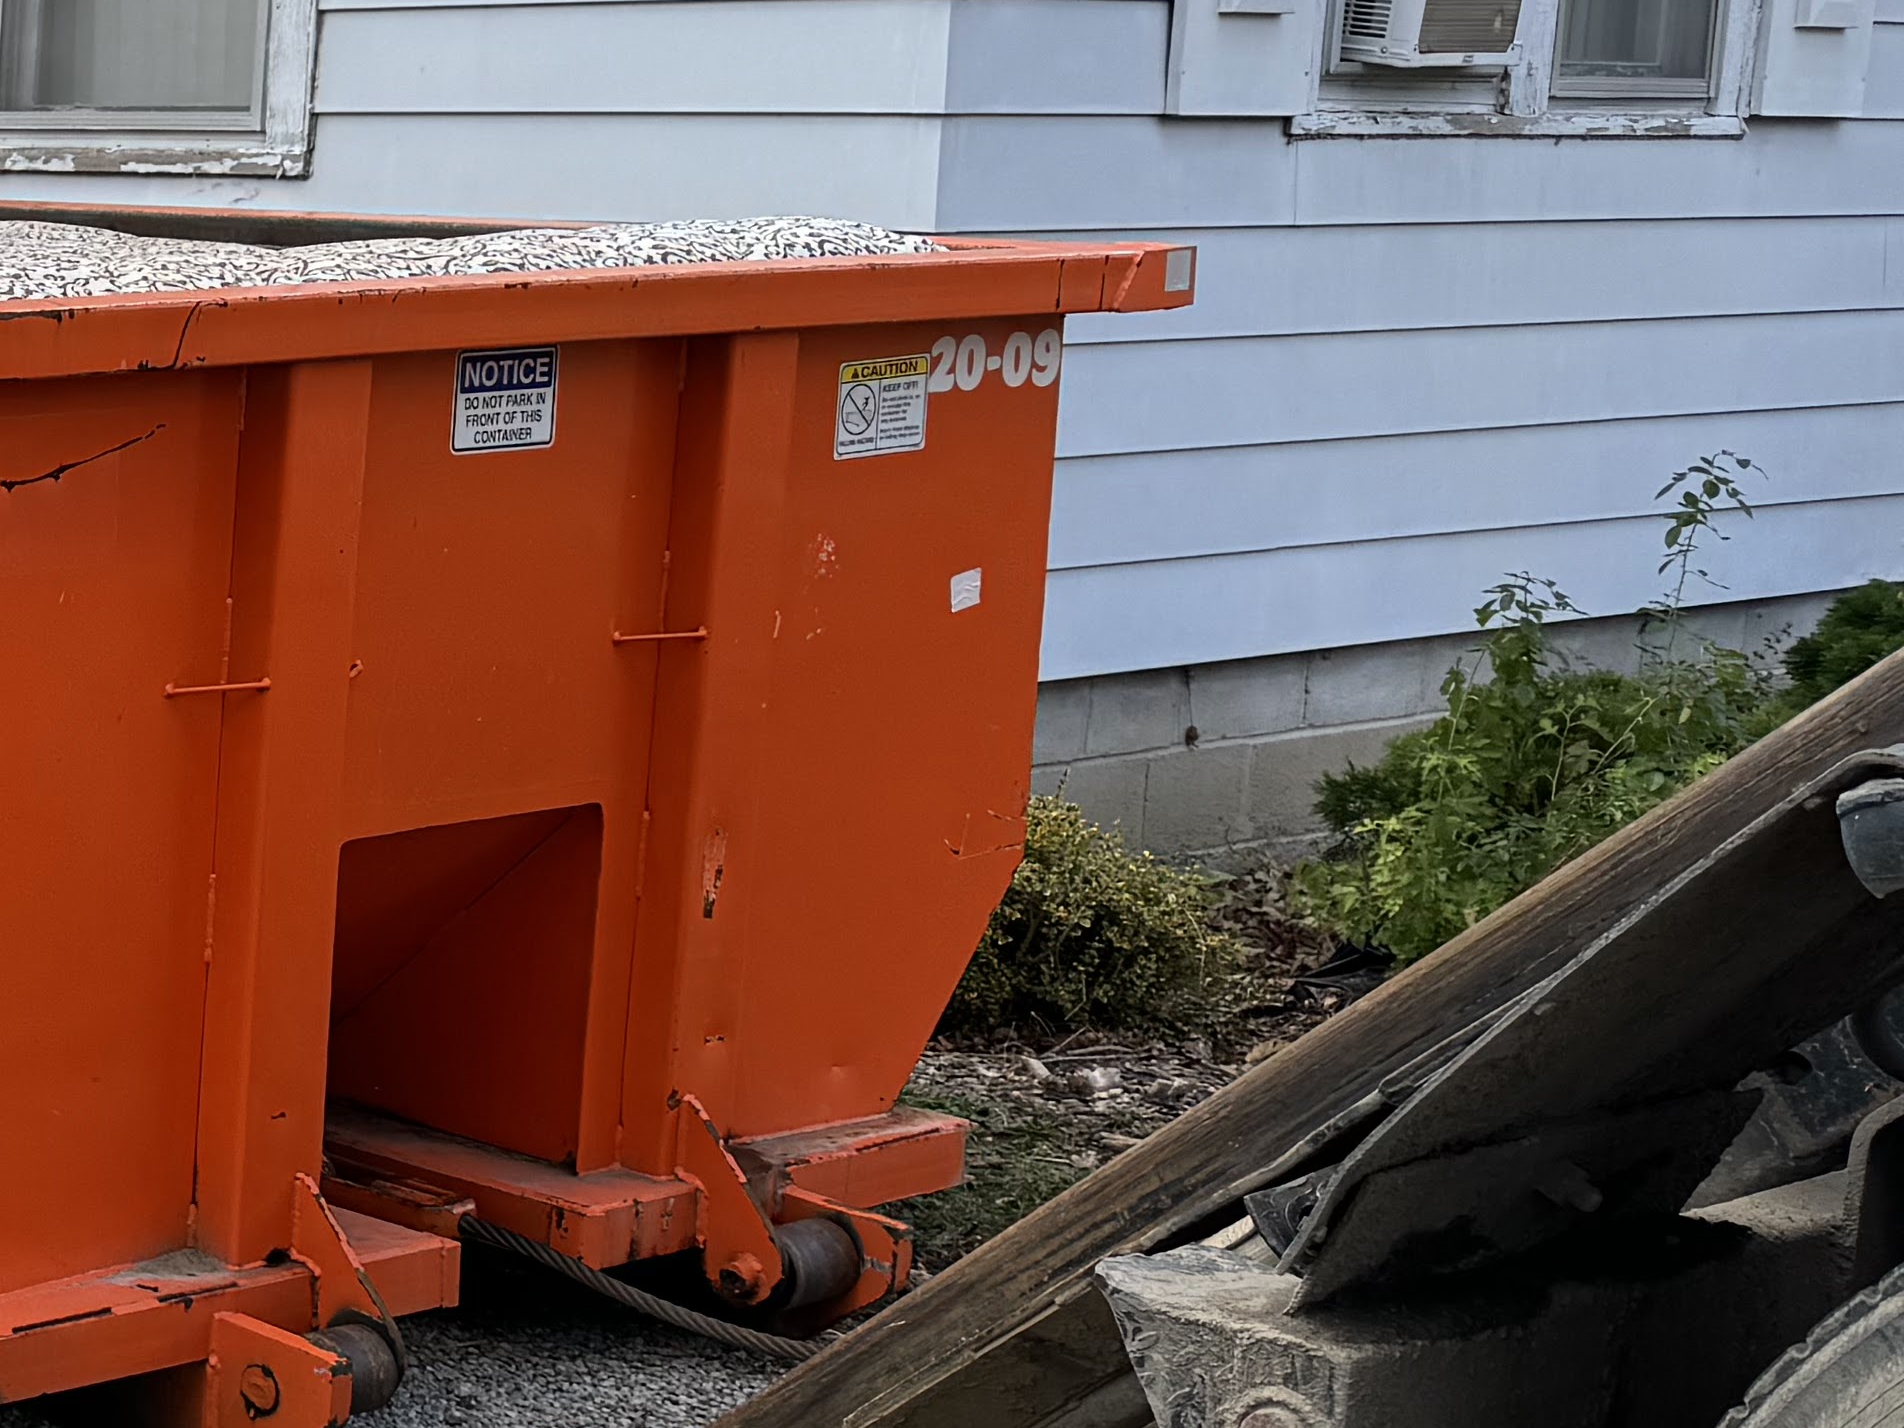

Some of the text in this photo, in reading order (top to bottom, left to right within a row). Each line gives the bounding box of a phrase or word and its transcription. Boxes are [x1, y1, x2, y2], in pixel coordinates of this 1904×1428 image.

[861, 360, 918, 379] CAUTION
[928, 329, 1061, 393] 20-09
[464, 357, 550, 388] NOTICE
[464, 392, 546, 410] DO NOT PARK IN
[466, 409, 542, 427] FRONT OF THIS
[474, 427, 532, 444] CONTAINER
